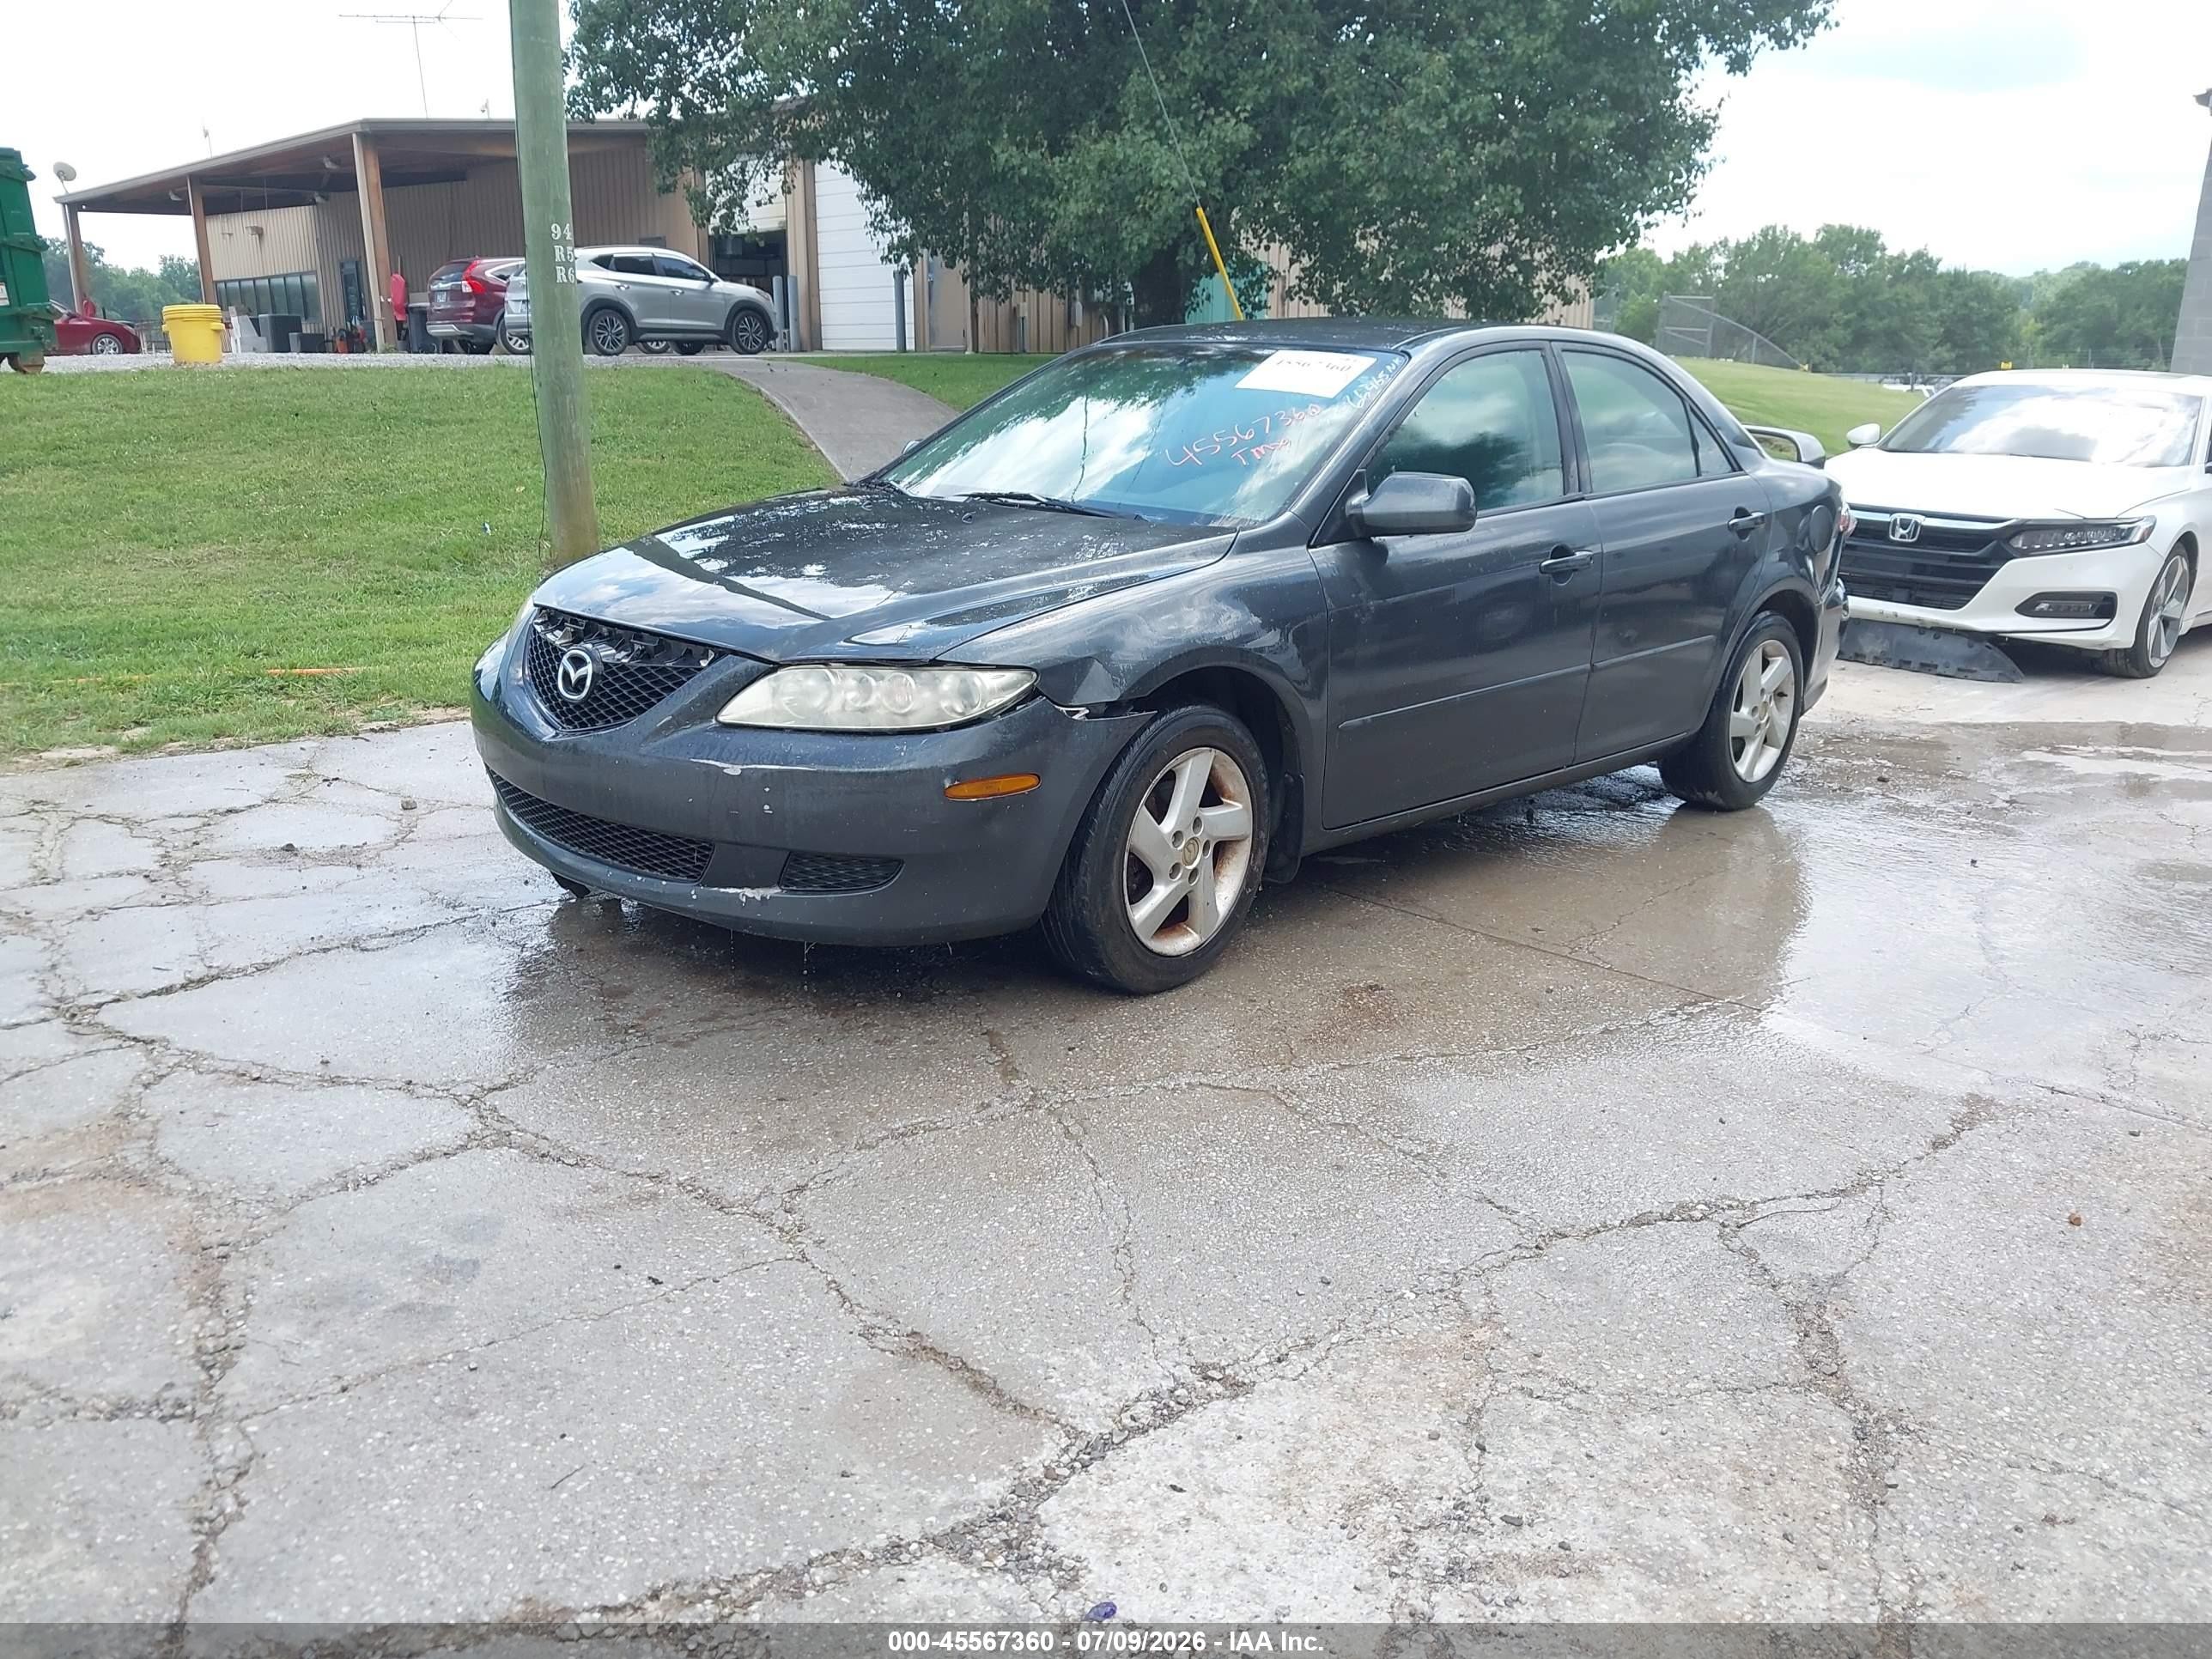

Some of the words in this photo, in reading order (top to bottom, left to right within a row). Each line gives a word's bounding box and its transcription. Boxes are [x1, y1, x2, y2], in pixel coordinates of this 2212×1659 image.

[550, 222, 573, 240] 94
[554, 245, 574, 263] R5
[556, 265, 575, 284] R6
[1165, 403, 1322, 466] 45567360
